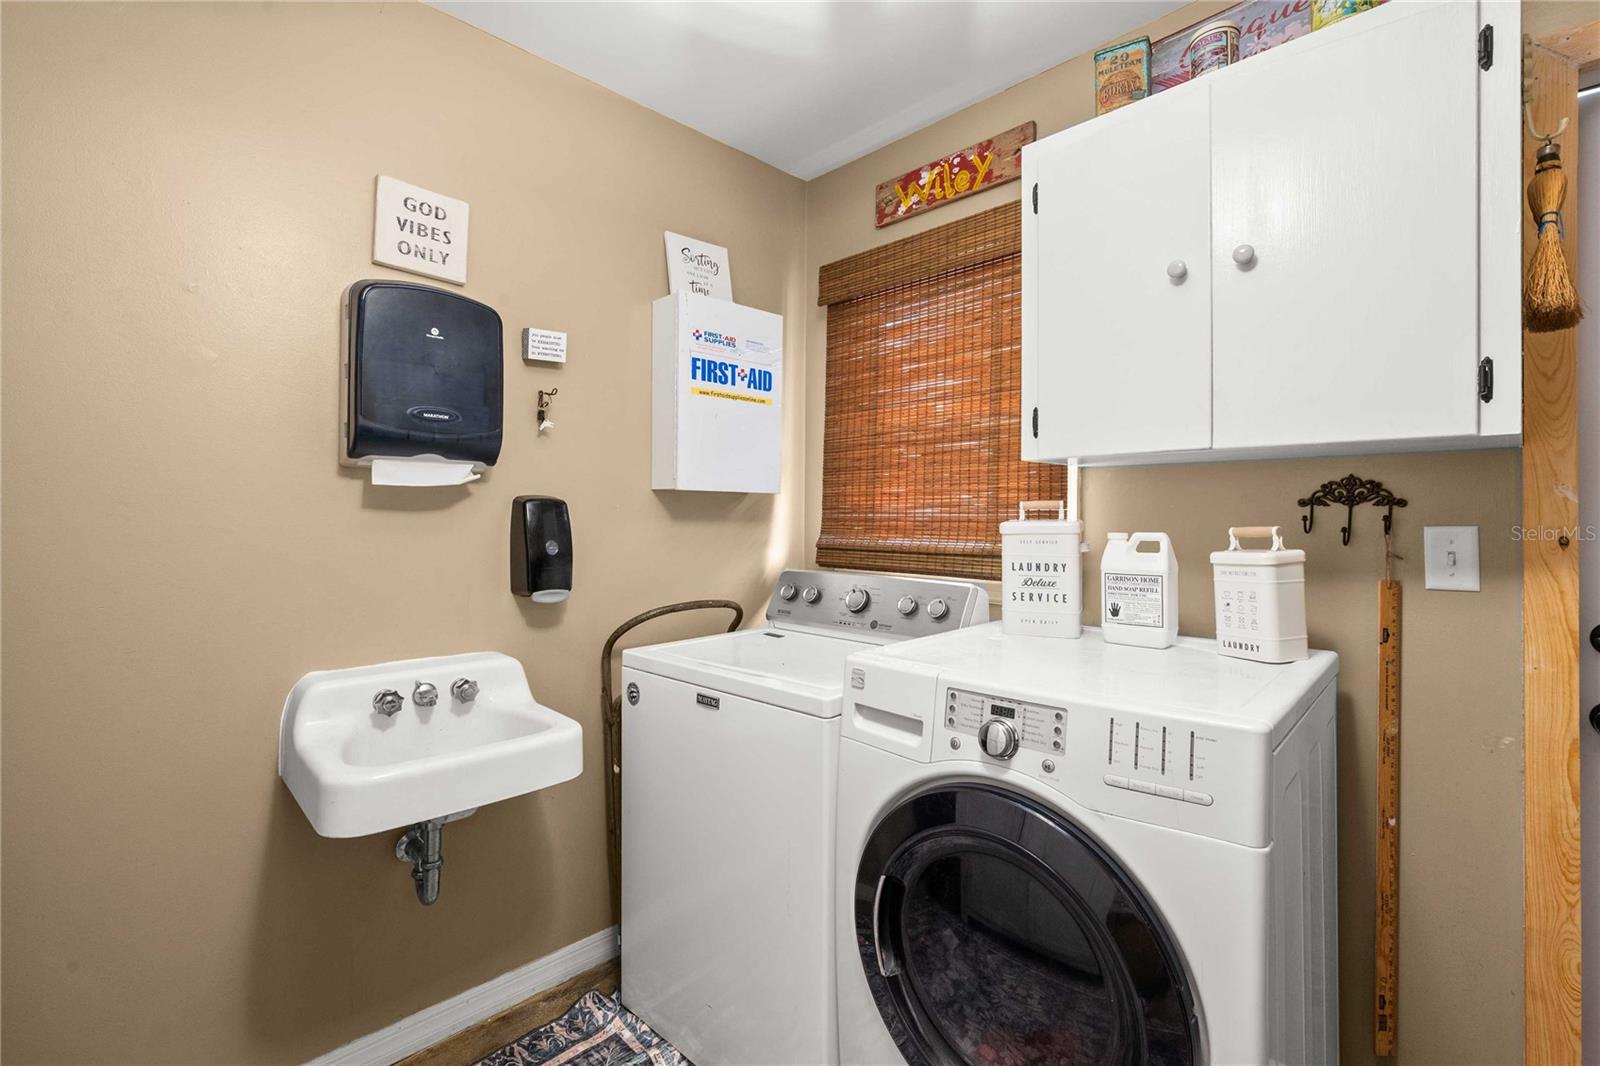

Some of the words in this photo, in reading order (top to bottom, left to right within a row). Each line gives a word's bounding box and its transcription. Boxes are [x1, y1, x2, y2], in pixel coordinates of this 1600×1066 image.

[895, 149, 993, 209] Wiley
[403, 196, 447, 221] GOD
[396, 216, 452, 245] VIBES
[397, 240, 450, 265] ONLY
[689, 280, 710, 296] time
[703, 336, 737, 348] SUPPLIES
[691, 356, 739, 387] FIRST
[747, 367, 773, 392] AID
[1011, 562, 1067, 573] LAUNDRY
[1022, 577, 1057, 588] Deluxe
[1012, 592, 1068, 604] SERVICE
[1222, 640, 1260, 653] LAUNDRY
